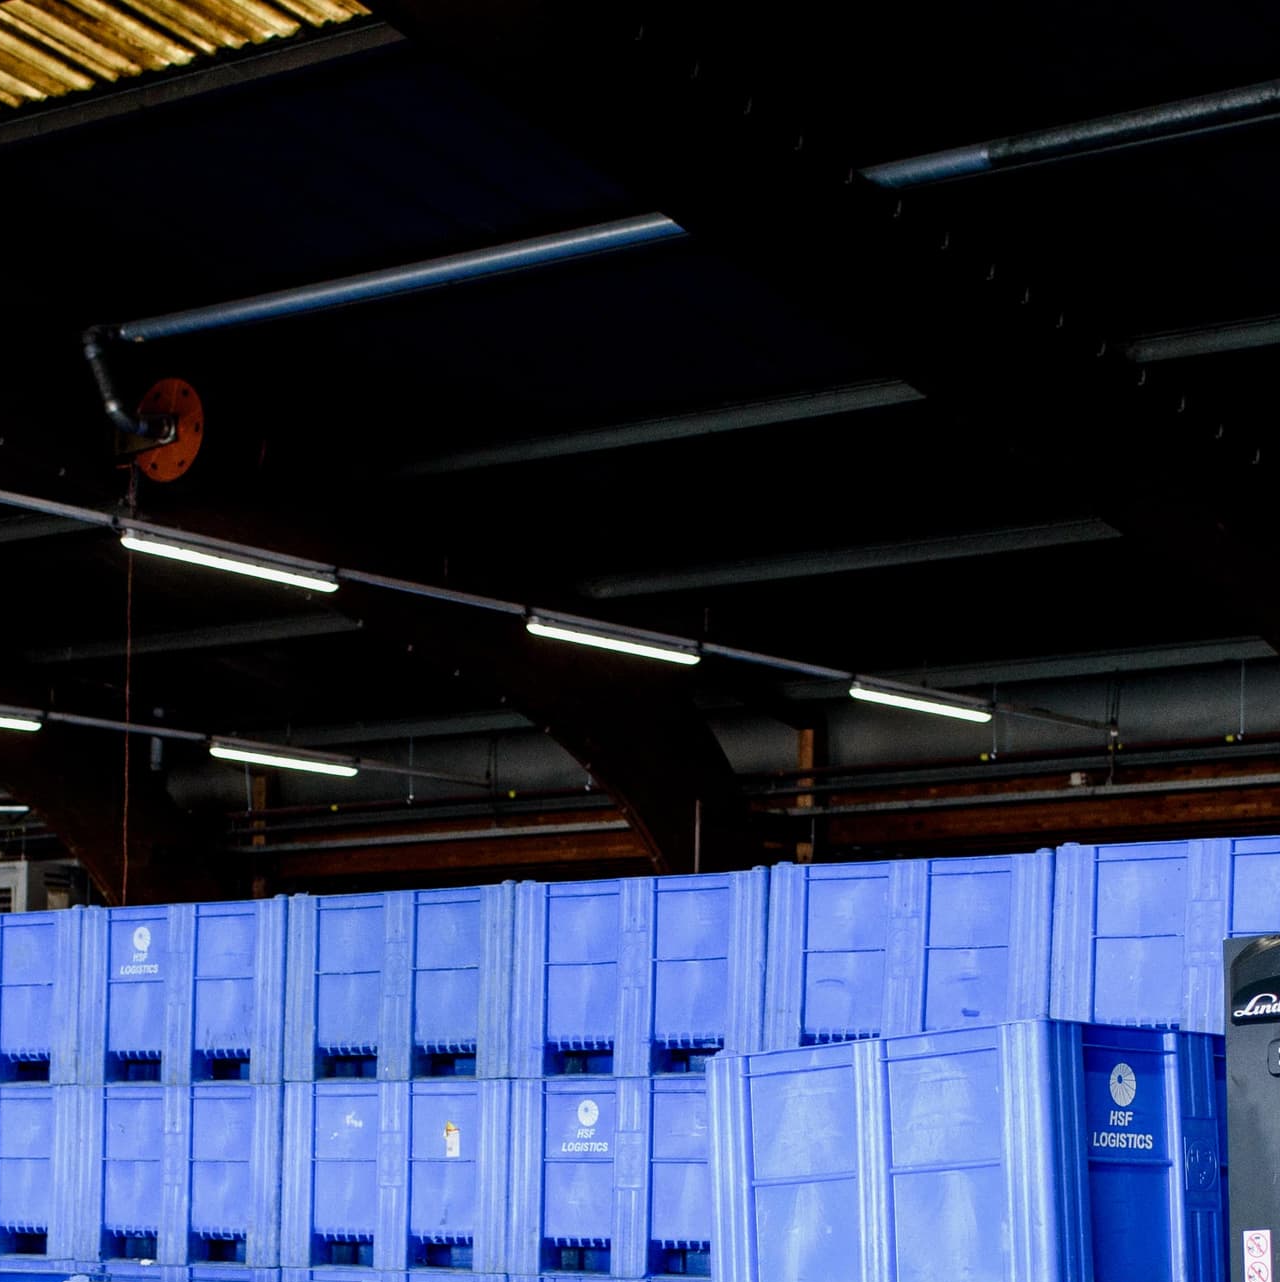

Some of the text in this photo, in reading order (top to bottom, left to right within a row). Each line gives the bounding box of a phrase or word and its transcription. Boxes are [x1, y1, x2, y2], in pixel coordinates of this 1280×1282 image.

[1110, 1110, 1134, 1126] HSF
[577, 1128, 596, 1139] HSF
[1093, 1131, 1153, 1149] LOGISTICS
[561, 1141, 609, 1152] LOGISTICS
